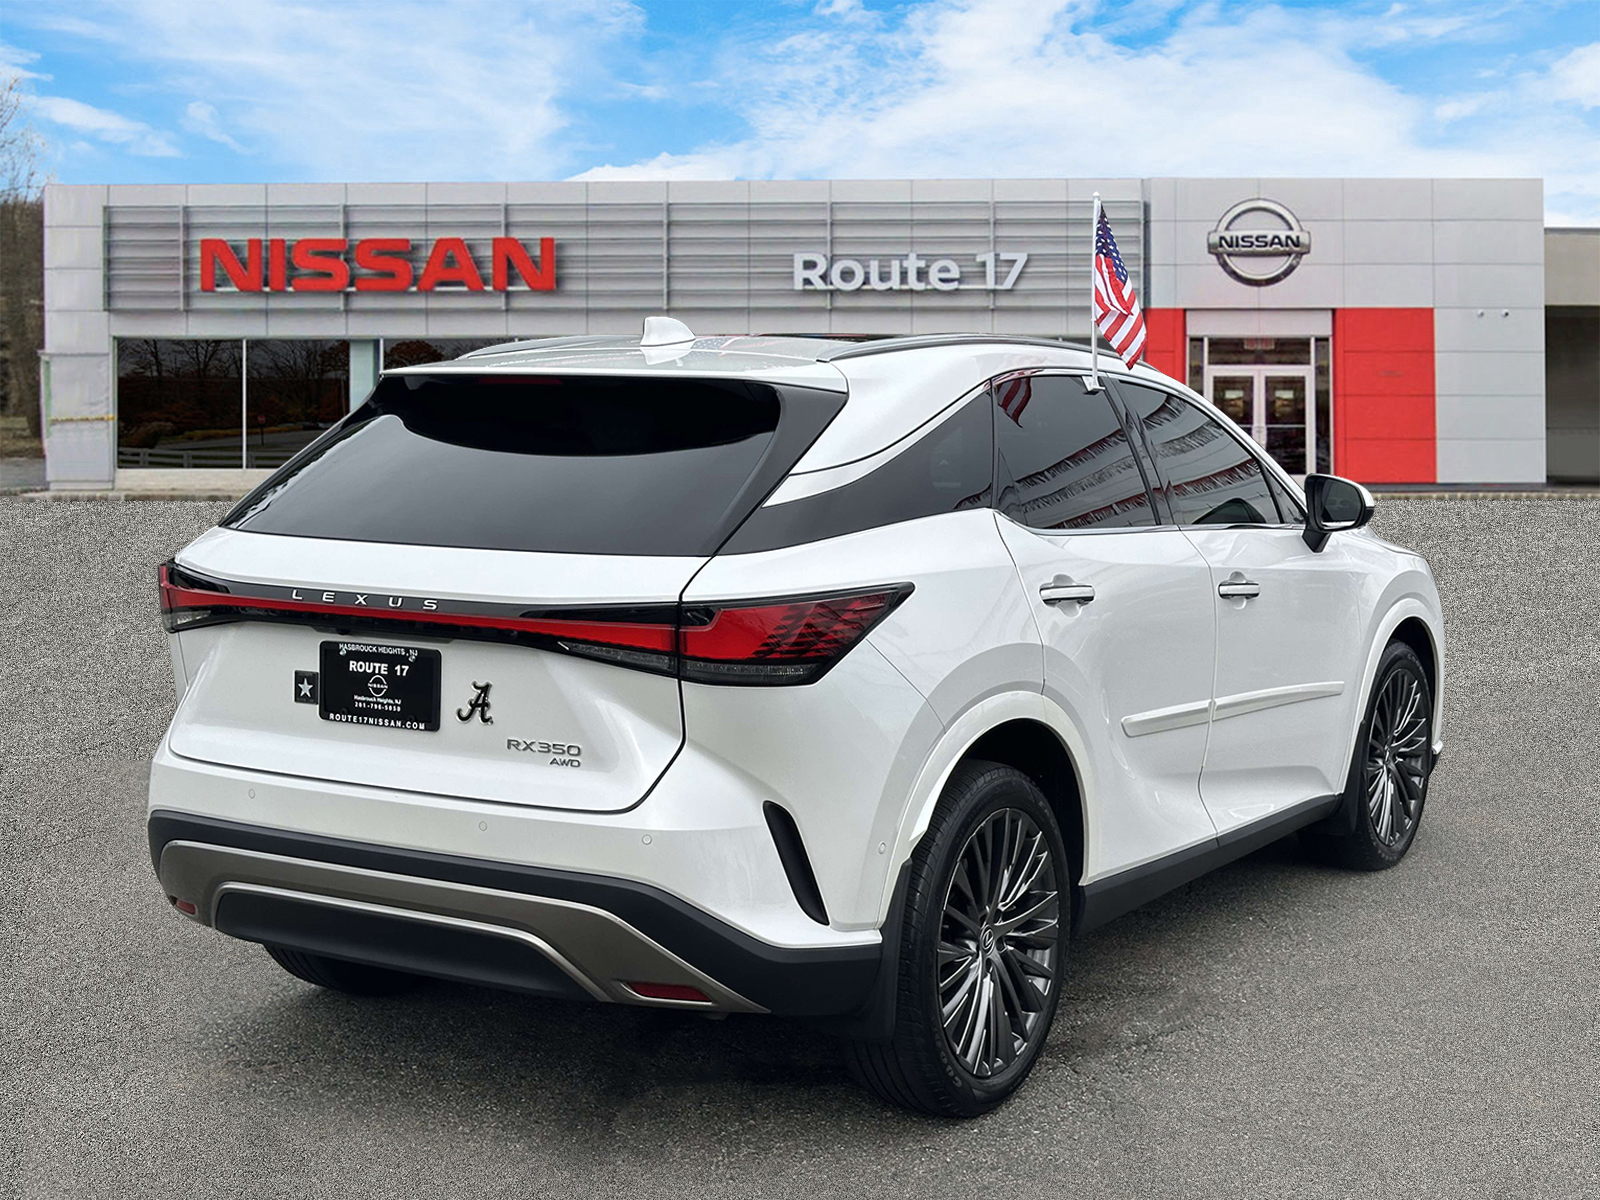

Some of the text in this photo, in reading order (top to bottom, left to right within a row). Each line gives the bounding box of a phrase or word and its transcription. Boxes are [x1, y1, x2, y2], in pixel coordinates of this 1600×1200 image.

[1219, 235, 1300, 248] NISSAN
[200, 237, 556, 292] NISSAN
[793, 252, 1028, 290] Route 17
[292, 589, 438, 610] LEXUS
[338, 643, 378, 653] HASBROUCK
[349, 660, 409, 677] ROUTE 17
[329, 713, 425, 730] ROUTE17NISSAN.COM
[507, 739, 582, 757] RX350
[549, 757, 581, 768] AWD
